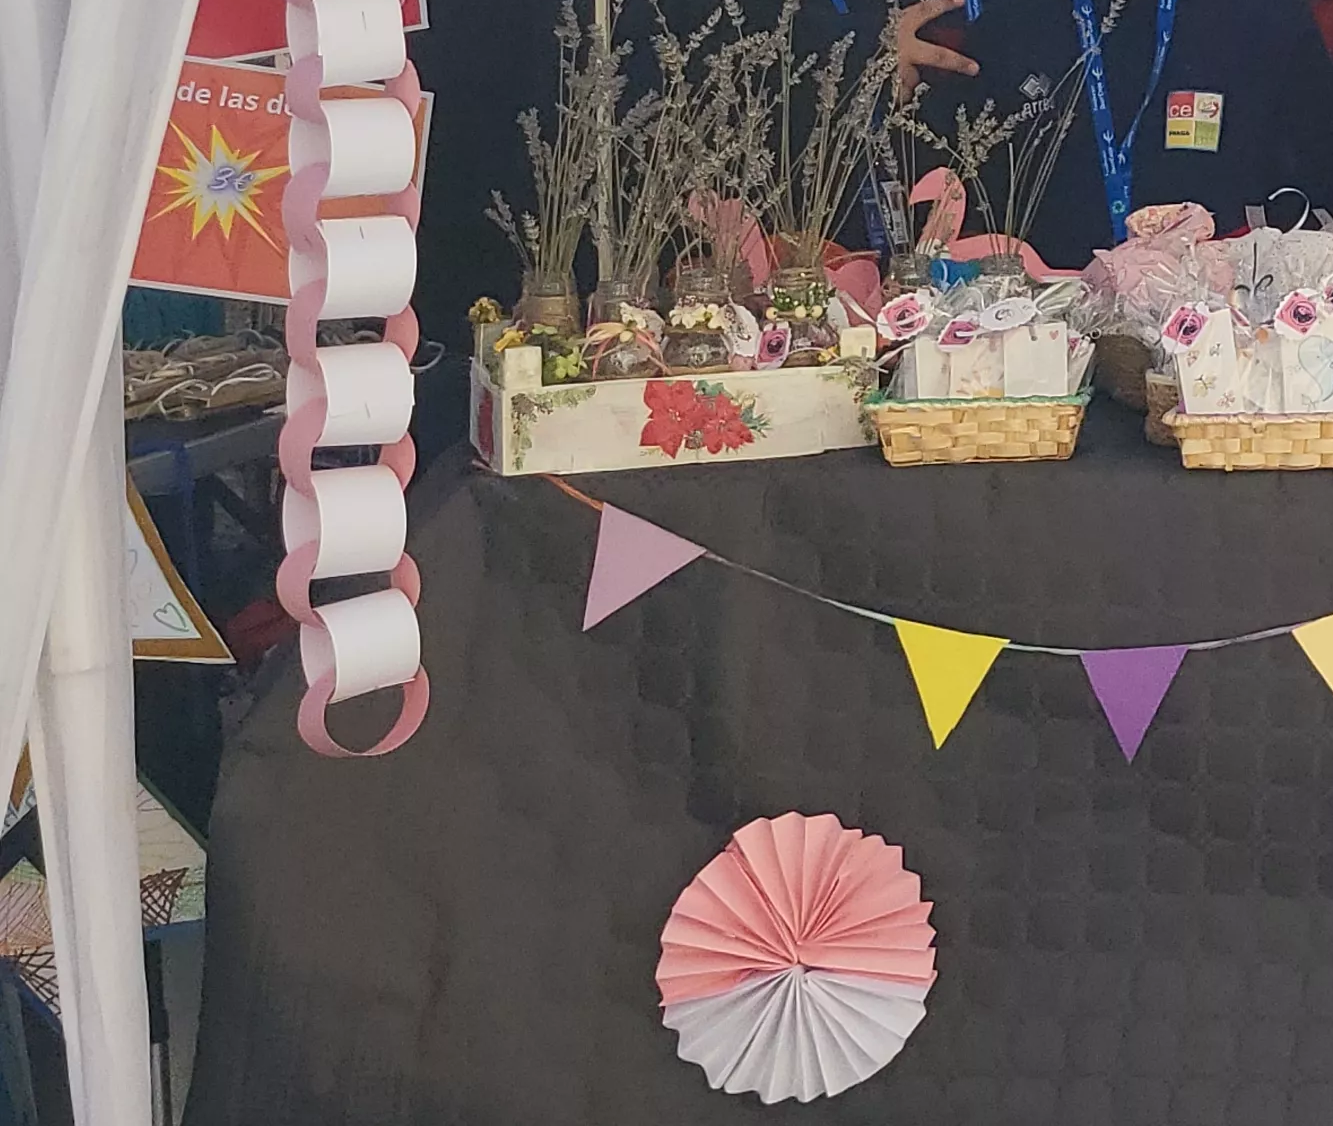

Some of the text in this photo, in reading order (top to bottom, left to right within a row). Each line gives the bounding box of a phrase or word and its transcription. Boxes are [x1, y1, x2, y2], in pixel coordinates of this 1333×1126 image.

[176, 80, 210, 104] de
[219, 85, 258, 112] las
[1169, 103, 1193, 118] ce
